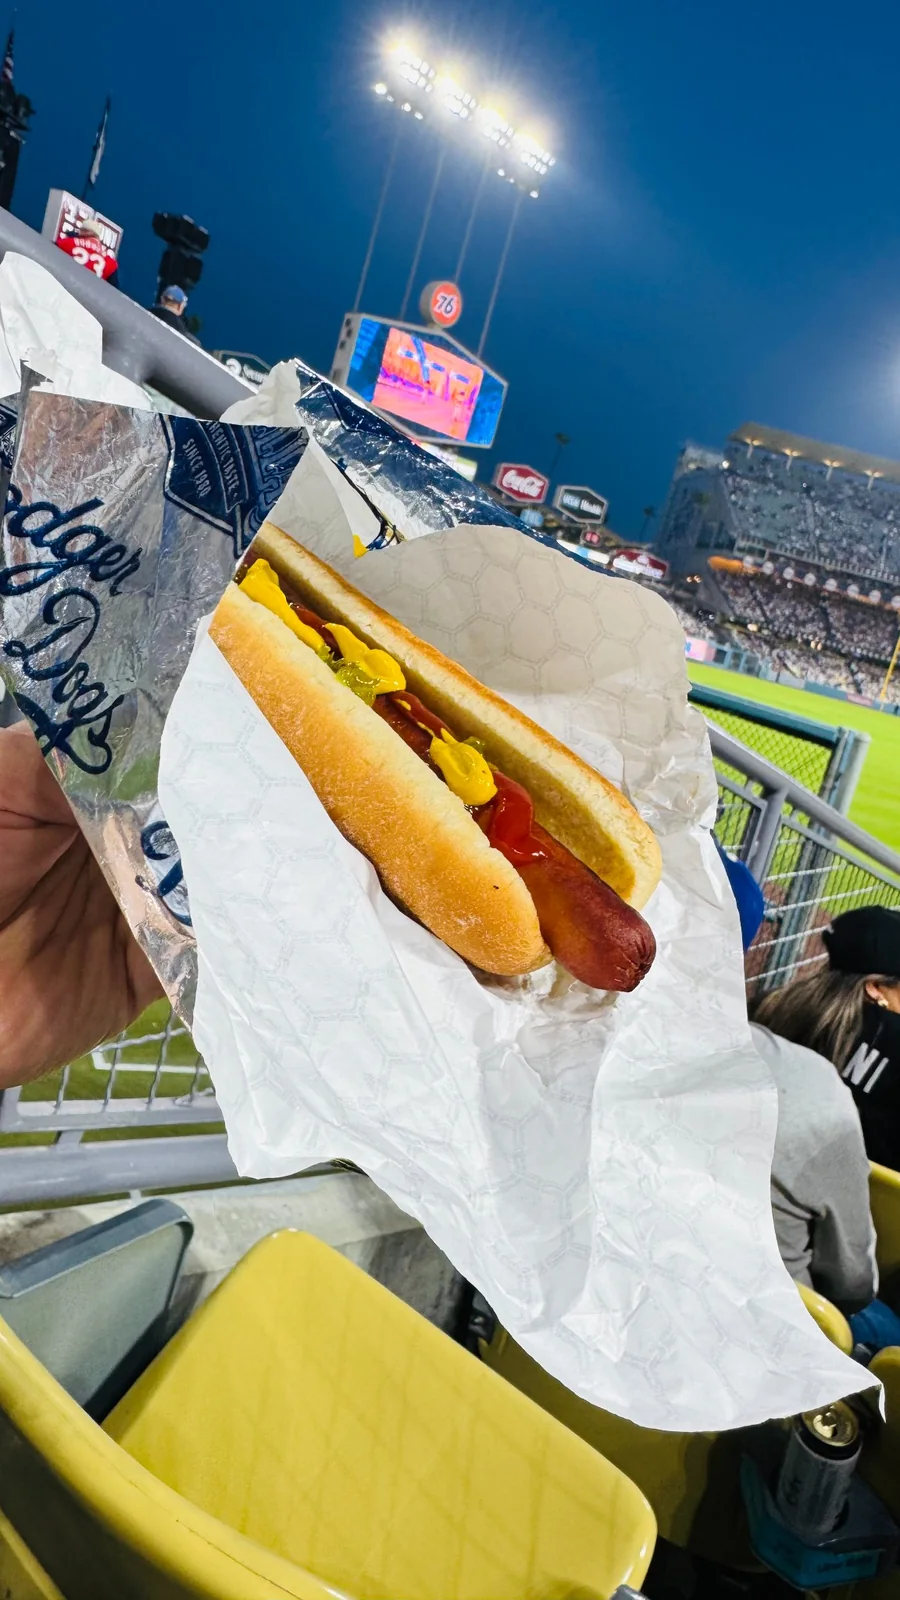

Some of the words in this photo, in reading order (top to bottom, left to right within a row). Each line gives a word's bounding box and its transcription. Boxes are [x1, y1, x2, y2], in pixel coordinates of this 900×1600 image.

[435, 293, 457, 316] 76
[182, 438, 203, 471] SINCE
[194, 469, 212, 498] 1980
[223, 458, 239, 492] TASTE
